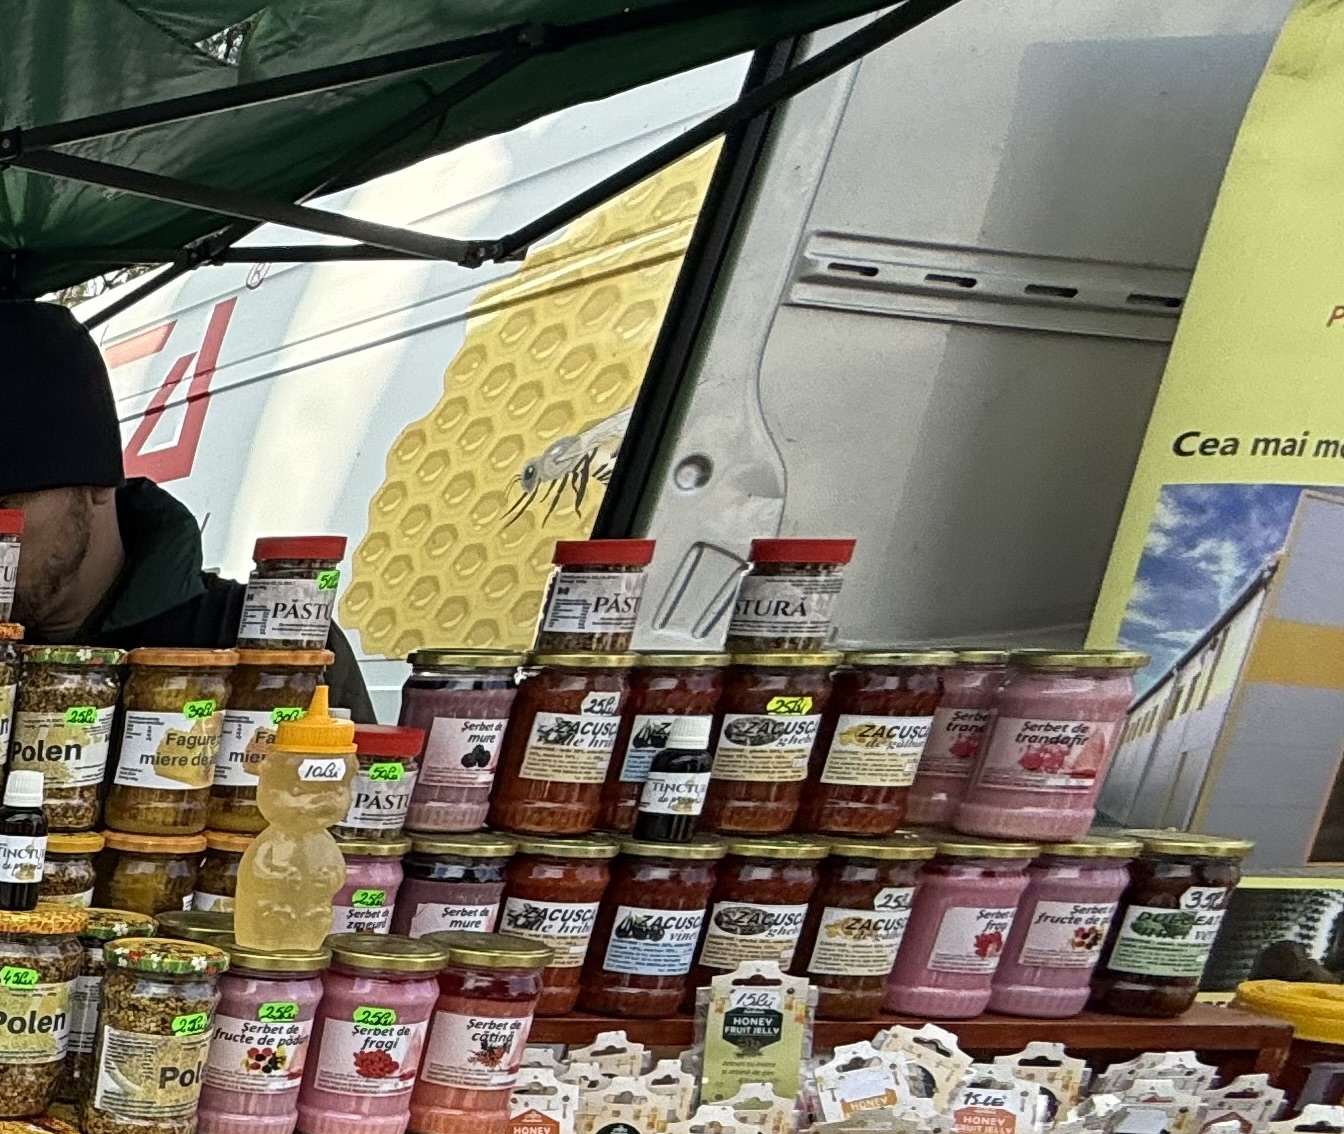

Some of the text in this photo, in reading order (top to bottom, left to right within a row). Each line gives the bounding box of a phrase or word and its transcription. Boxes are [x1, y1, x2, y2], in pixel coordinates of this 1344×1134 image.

[1171, 431, 1239, 456] Cea
[1251, 431, 1309, 457] mai
[468, 732, 496, 743] mure
[11, 741, 82, 761] Polen
[139, 751, 187, 767] miere
[449, 918, 482, 929] mure
[504, 1020, 521, 1031] de
[733, 1017, 773, 1026] HONEY
[280, 1024, 299, 1036] de
[393, 1025, 411, 1037] de
[724, 1026, 780, 1035] FRUIT JELLY
[214, 1028, 274, 1046] fructe de
[963, 1116, 1006, 1126] HONEY
